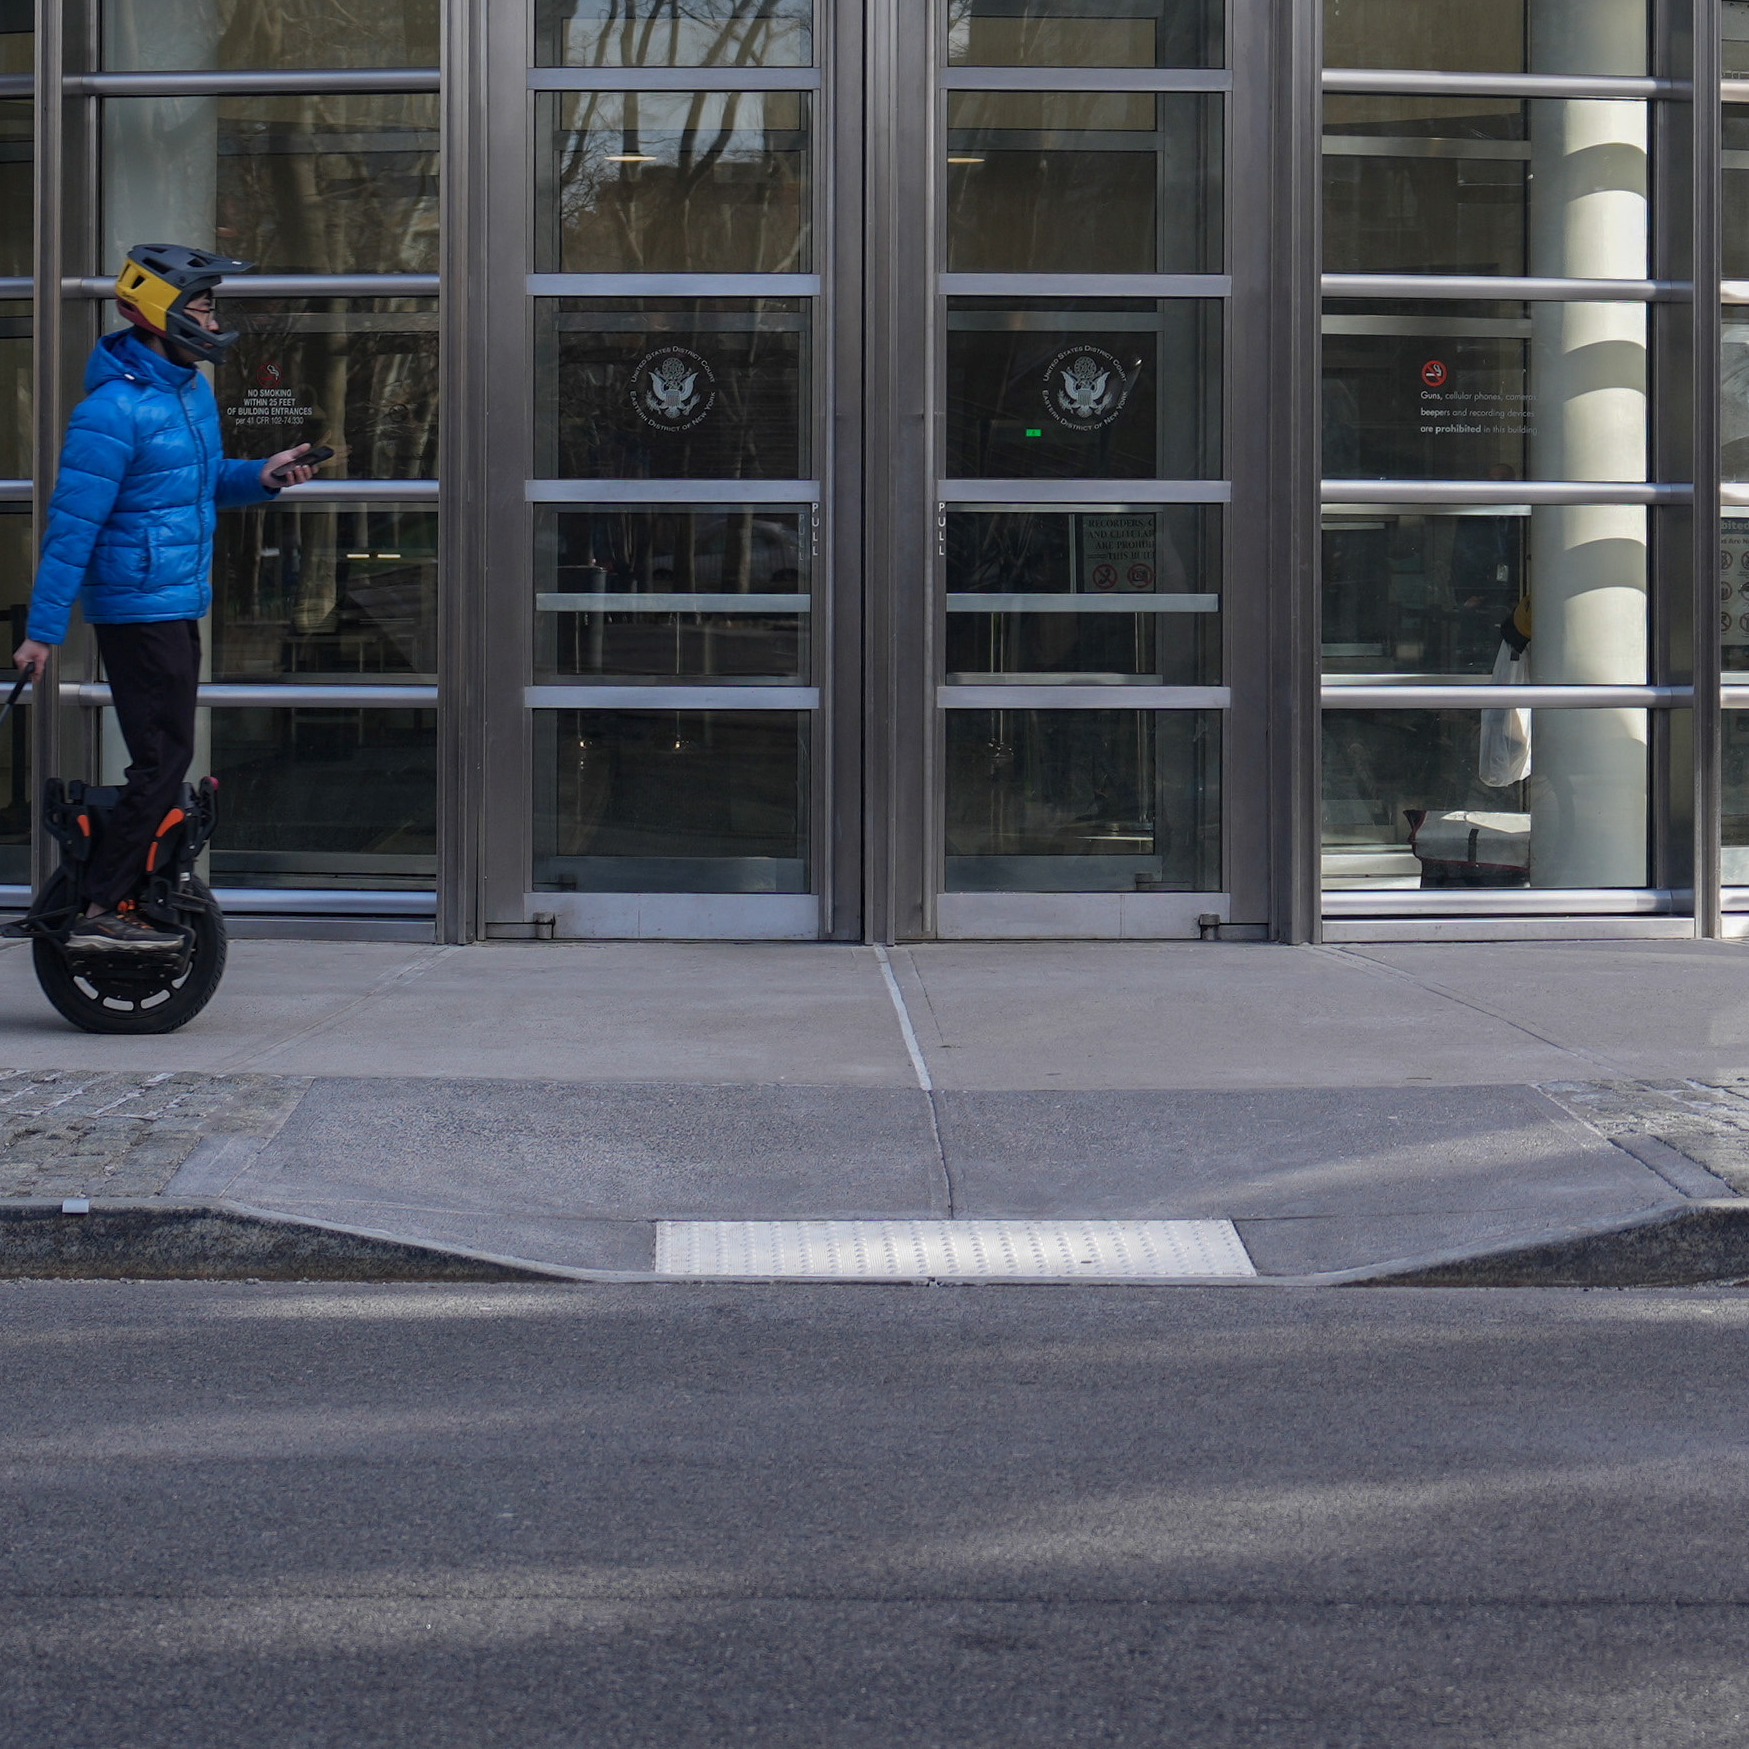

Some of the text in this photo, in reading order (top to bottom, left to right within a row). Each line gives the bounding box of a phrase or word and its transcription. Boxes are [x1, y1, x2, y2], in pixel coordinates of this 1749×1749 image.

[247, 389, 292, 397] NO SMOKING
[1420, 391, 1443, 400] Guns,
[1445, 391, 1472, 400] cellular
[1474, 391, 1503, 402] phones,
[243, 398, 296, 406] WITHIN 25 FEET
[226, 407, 312, 415] OF BUILDING ENTRANCES
[1420, 408, 1534, 419] beepers and recording devices
[1435, 424, 1482, 434] prohibited
[1492, 425, 1505, 433] this
[812, 503, 820, 556] PULL
[938, 502, 946, 556] PULL
